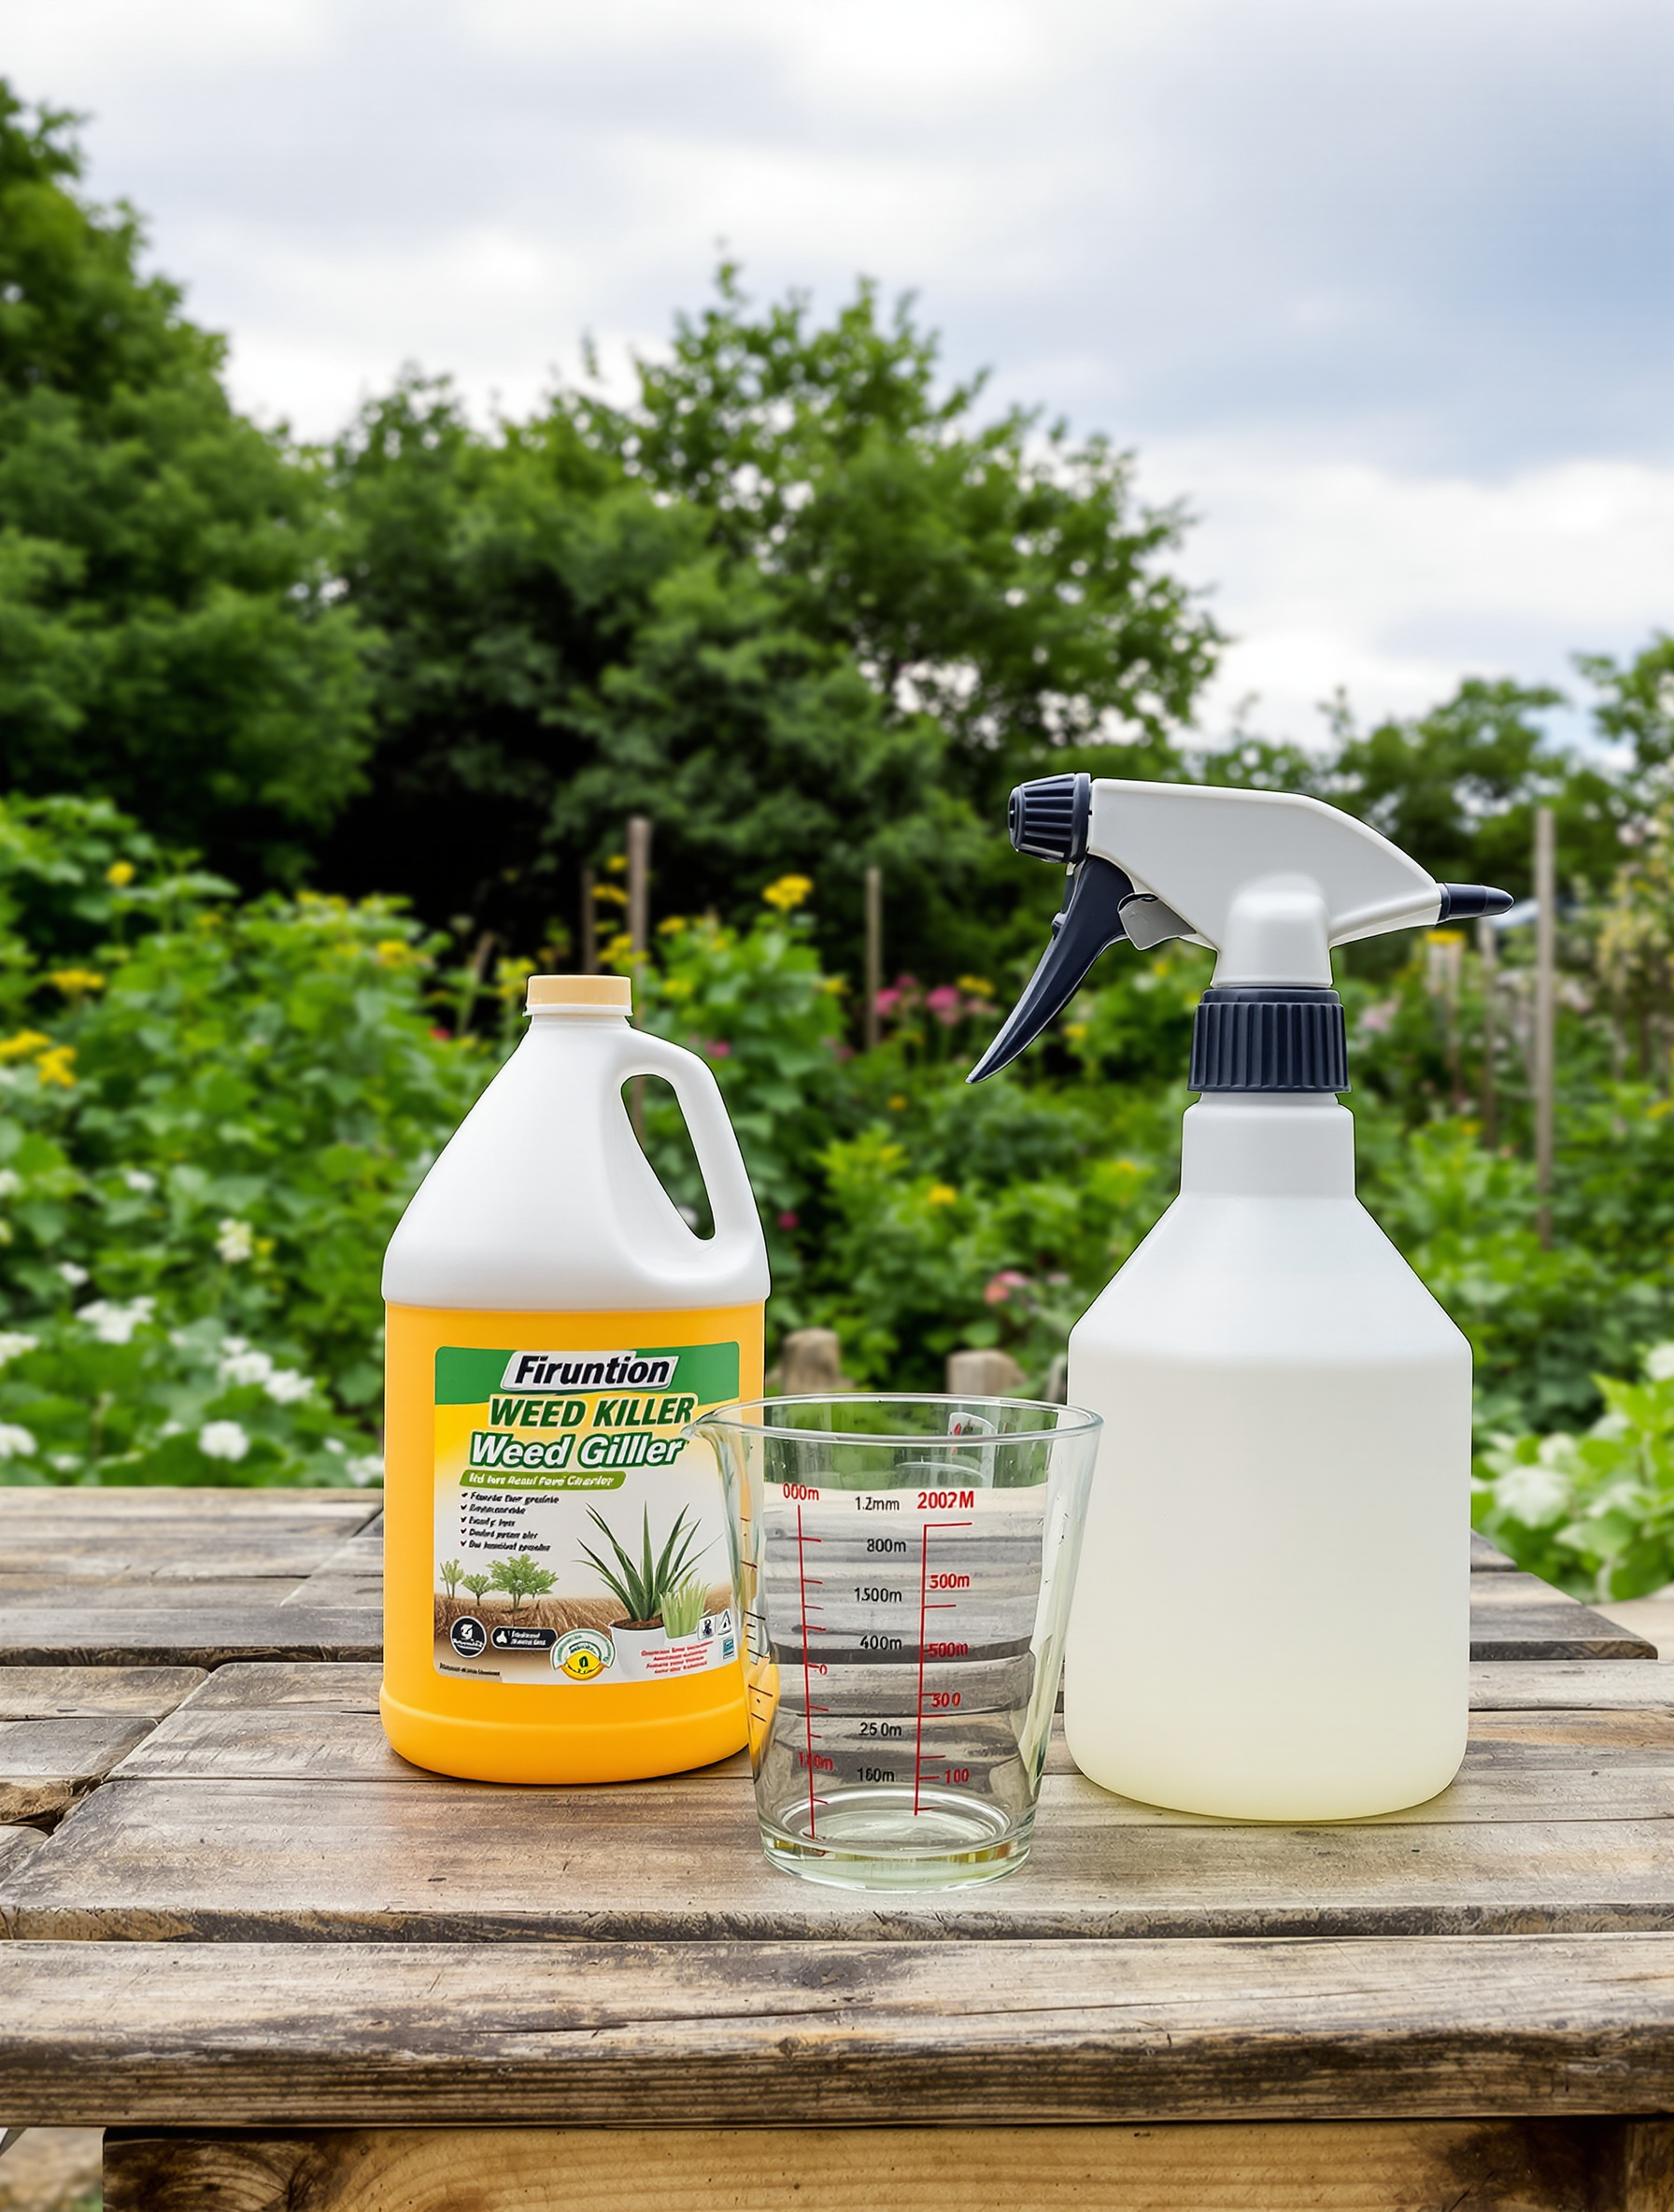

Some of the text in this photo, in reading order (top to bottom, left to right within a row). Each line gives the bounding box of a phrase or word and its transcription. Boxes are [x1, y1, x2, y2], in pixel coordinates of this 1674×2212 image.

[515, 1354, 671, 1385] Firuntion
[489, 1397, 696, 1427] WEED KILLER
[472, 1433, 572, 1466] Weed
[859, 1635, 902, 1650] 400m
[944, 1768, 971, 1784] 100
